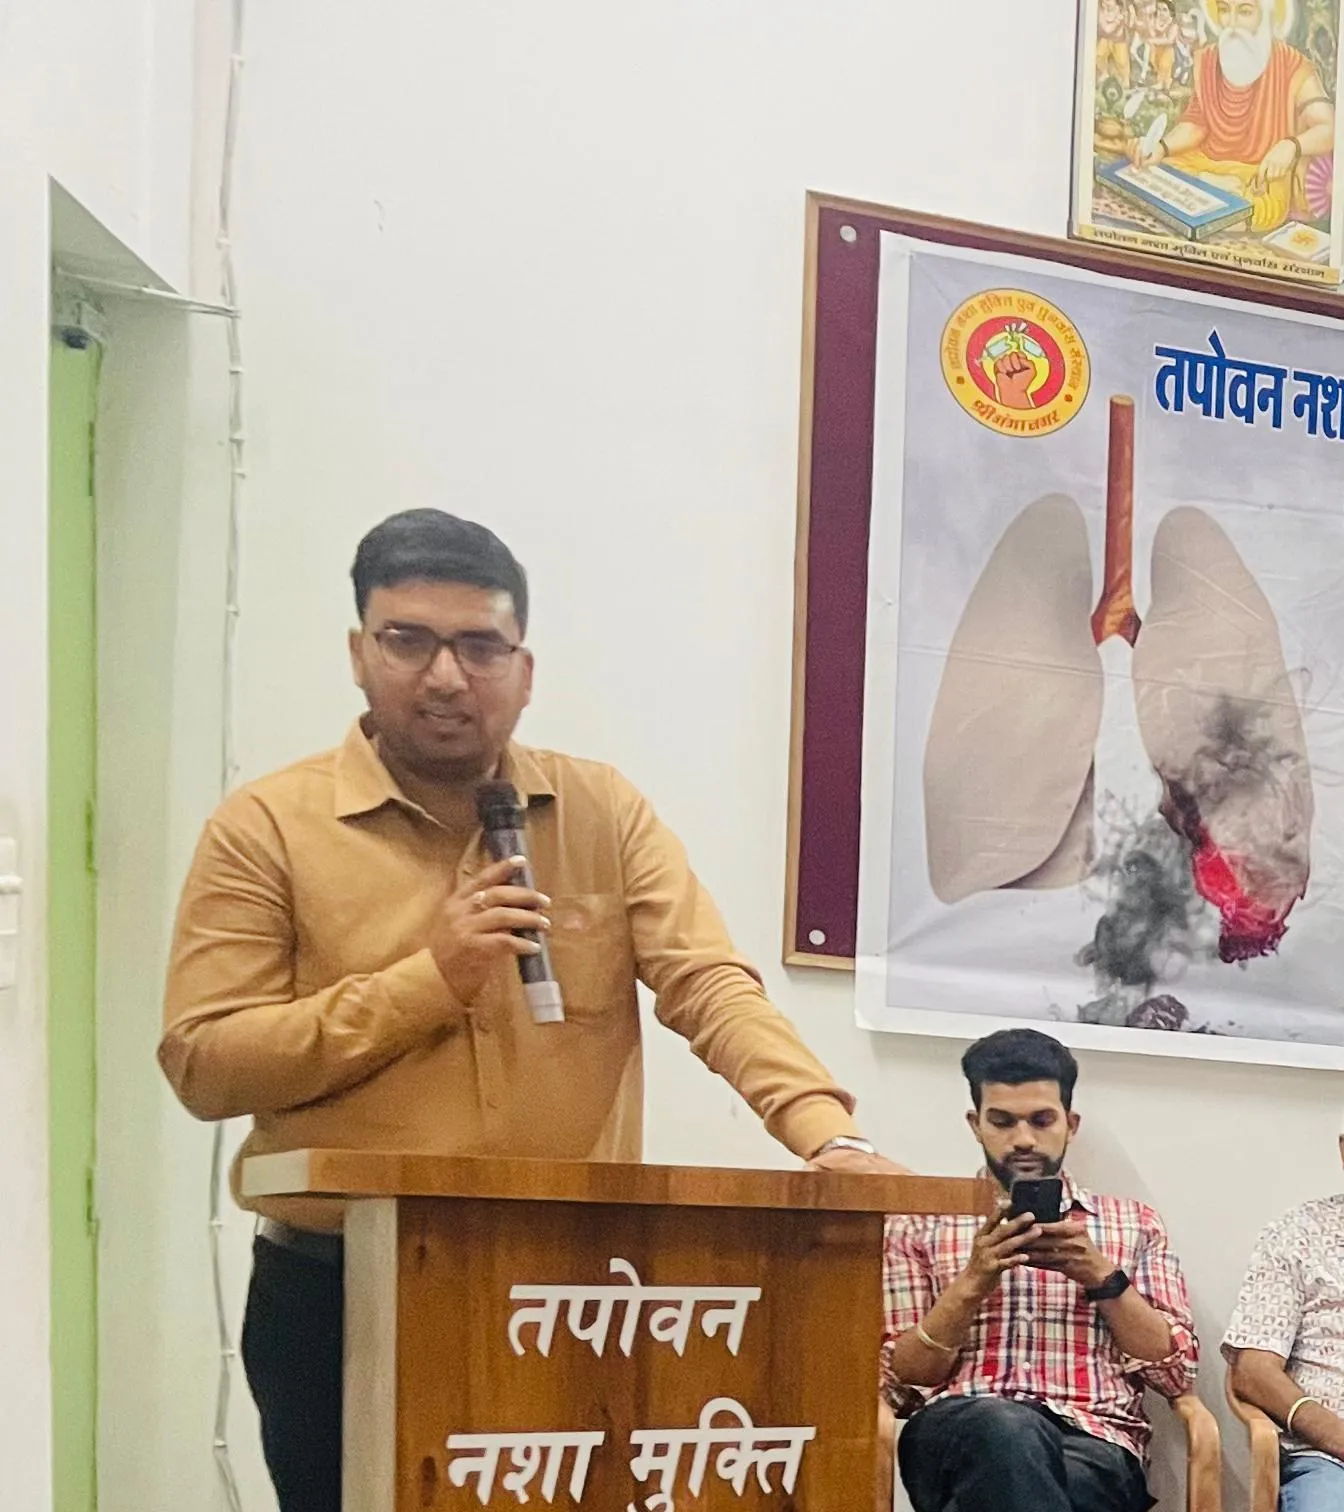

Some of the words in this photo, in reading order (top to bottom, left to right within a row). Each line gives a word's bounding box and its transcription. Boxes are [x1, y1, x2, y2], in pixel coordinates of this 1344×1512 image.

[1154, 329, 1287, 429] तपोवन
[508, 1257, 762, 1358] तपोवन
[446, 1431, 606, 1506] नशा
